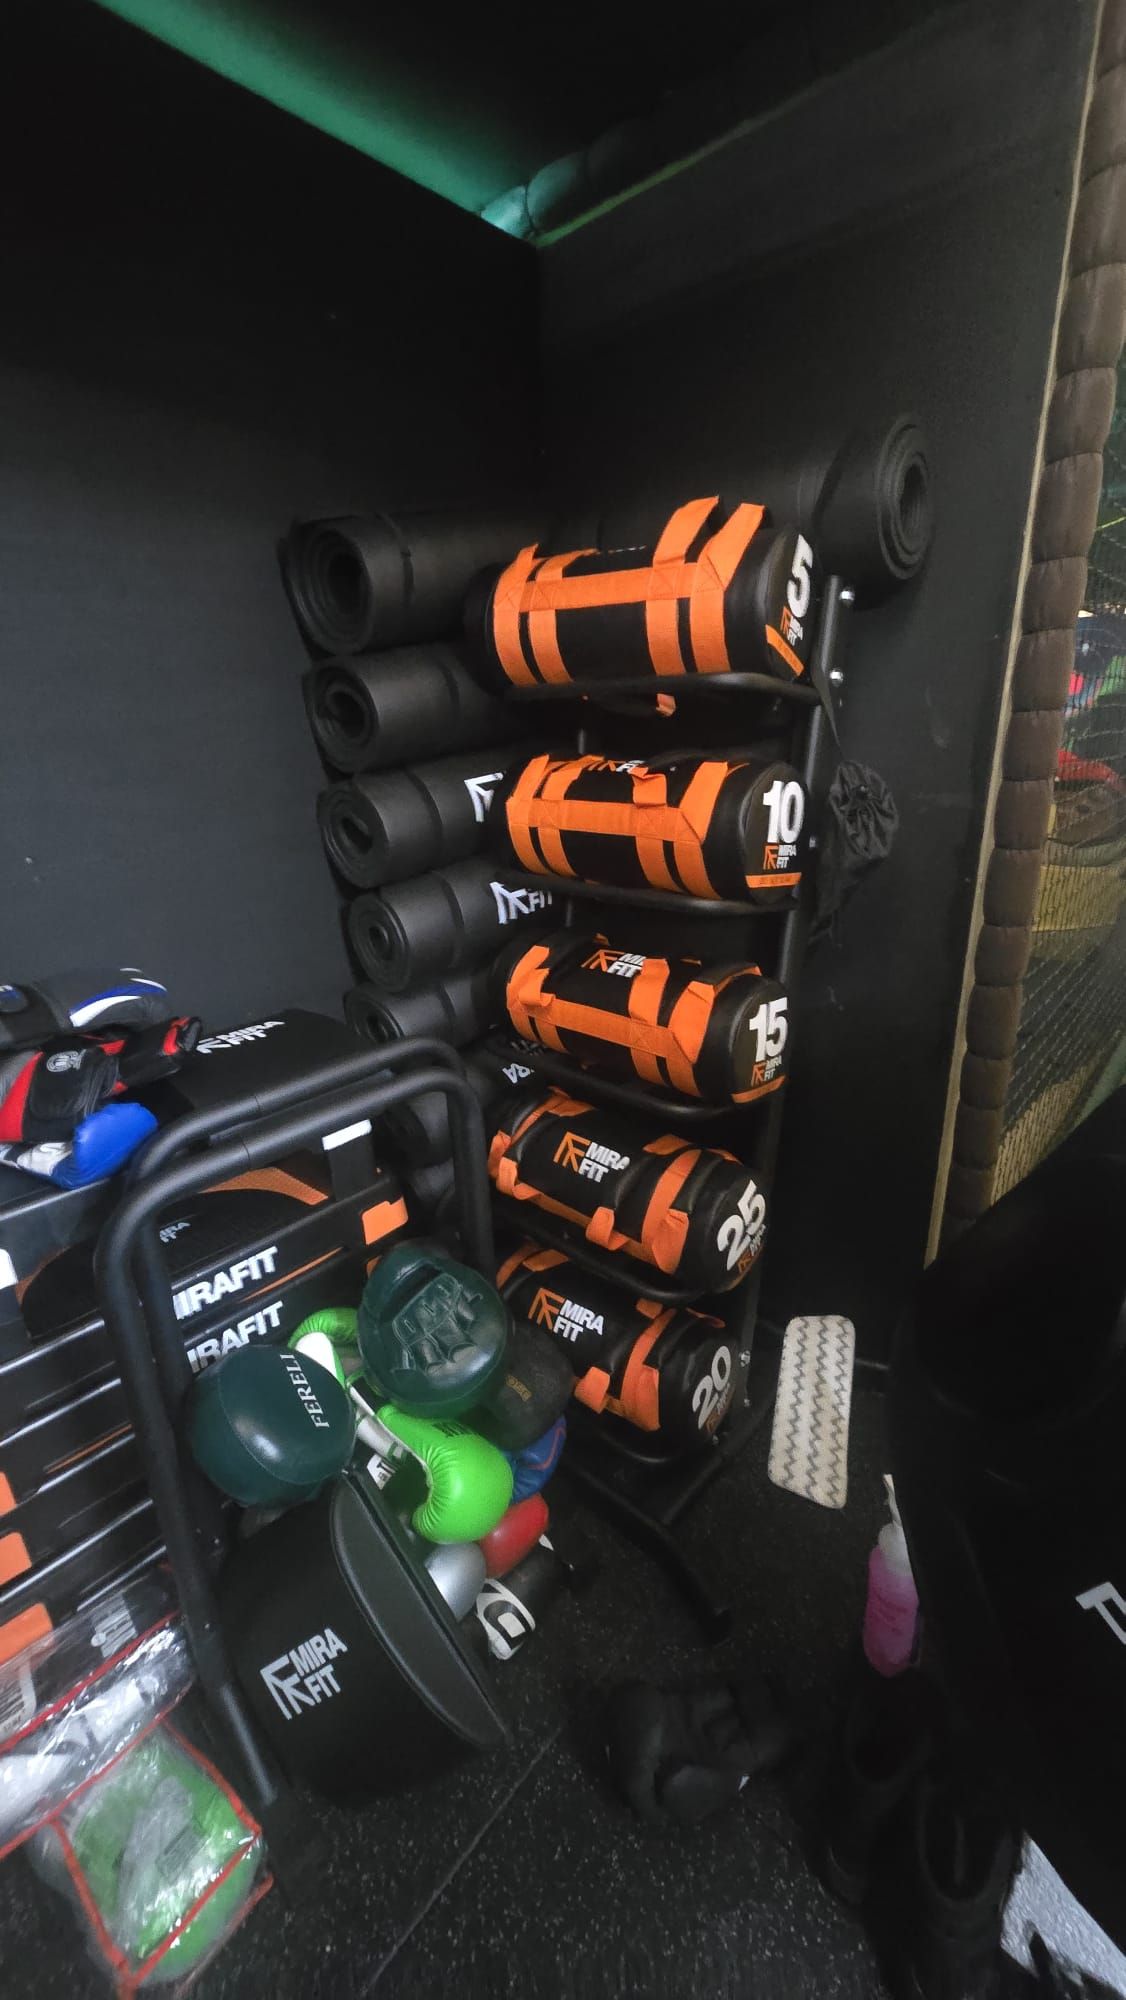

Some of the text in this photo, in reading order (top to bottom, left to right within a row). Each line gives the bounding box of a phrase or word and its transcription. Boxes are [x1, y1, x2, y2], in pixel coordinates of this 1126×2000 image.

[786, 534, 814, 618] 5
[762, 780, 805, 844] 10
[617, 952, 647, 968] MI
[748, 996, 789, 1063] 15
[578, 1157, 610, 1183] FIT
[586, 1141, 631, 1171] MIRA
[716, 1179, 767, 1272] 25
[553, 1315, 584, 1342] FIT
[559, 1298, 605, 1336] MIRA
[279, 1354, 331, 1428] FERELI
[692, 1345, 732, 1431] 20
[288, 1627, 348, 1677] MIRA
[303, 1663, 342, 1704] FIT
